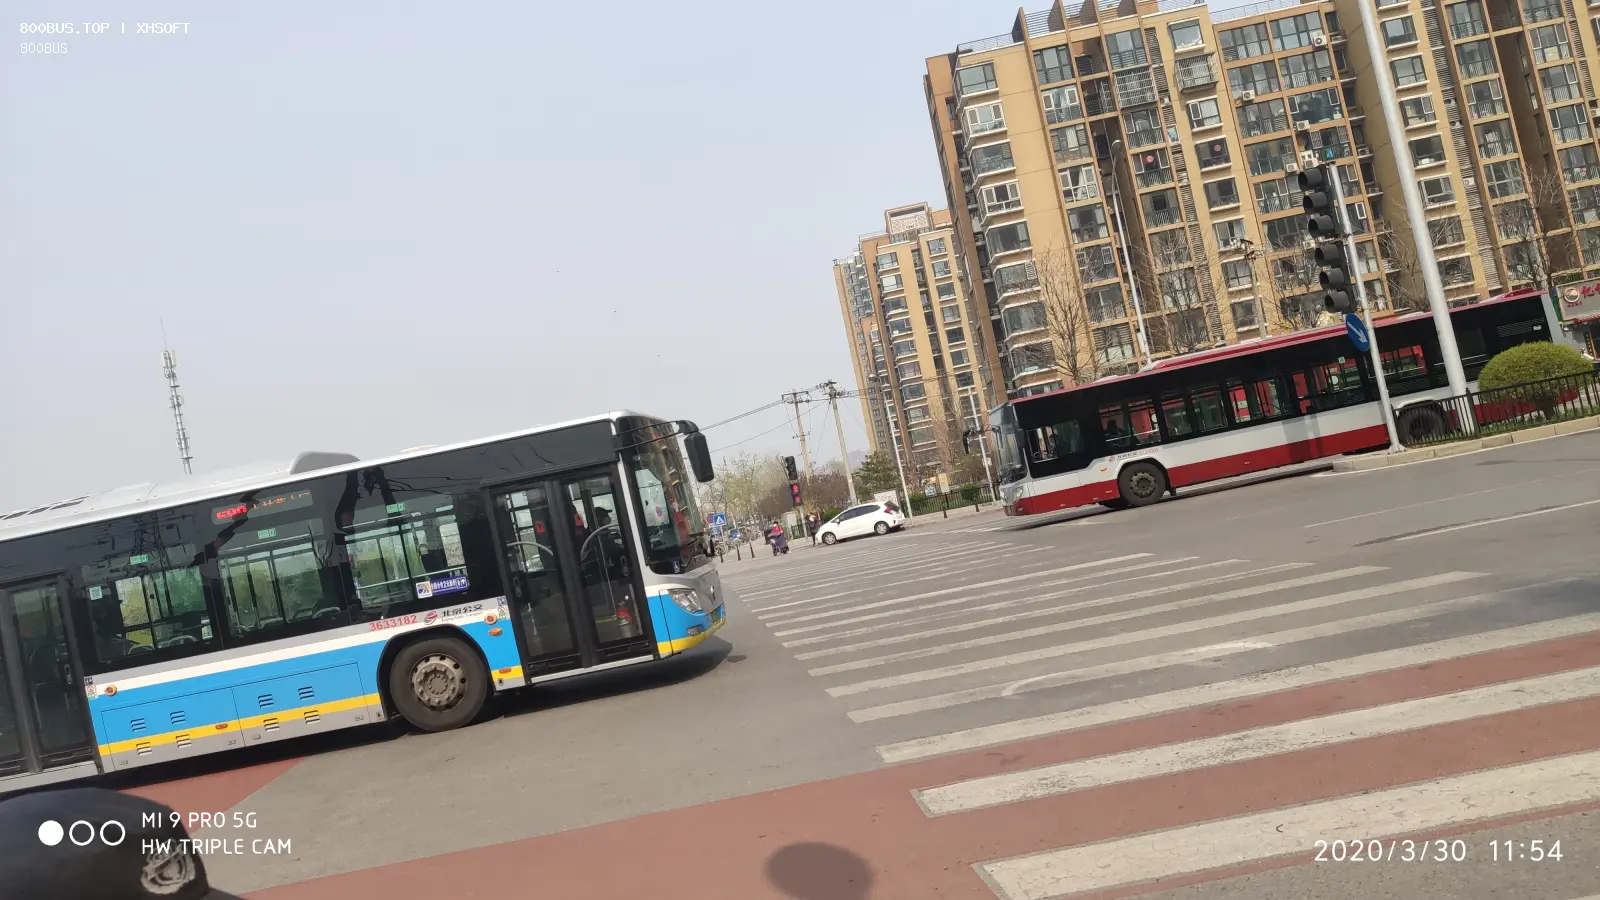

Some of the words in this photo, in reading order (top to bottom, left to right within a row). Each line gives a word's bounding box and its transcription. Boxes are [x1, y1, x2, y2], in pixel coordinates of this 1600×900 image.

[441, 603, 483, 617] 北京公交
[369, 614, 418, 632] 3633182
